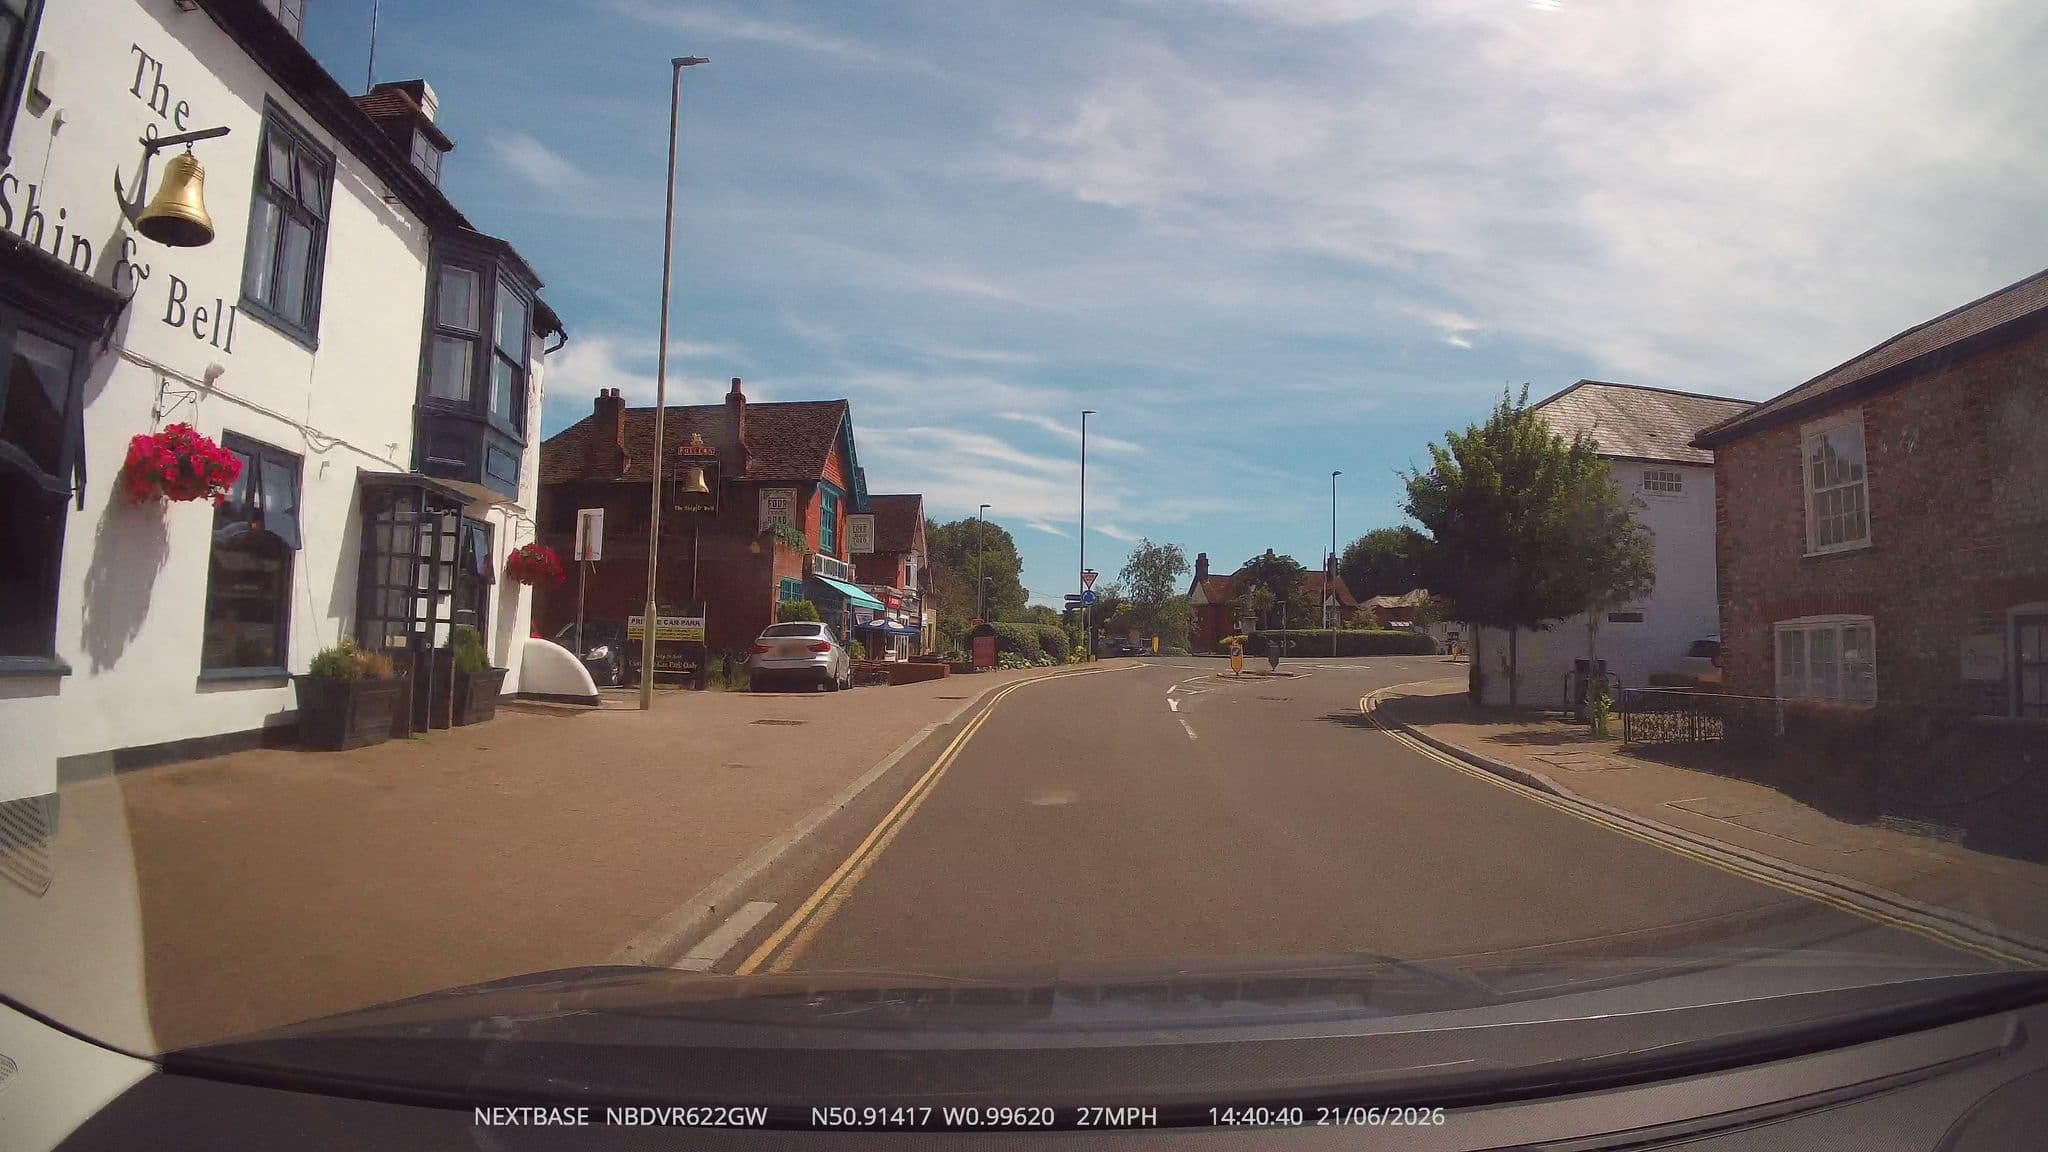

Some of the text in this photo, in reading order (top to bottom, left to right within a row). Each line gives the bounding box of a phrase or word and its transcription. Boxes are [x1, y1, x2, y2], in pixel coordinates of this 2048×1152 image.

[130, 43, 190, 131] The
[0, 173, 92, 274] Ship
[162, 274, 236, 354] Bell
